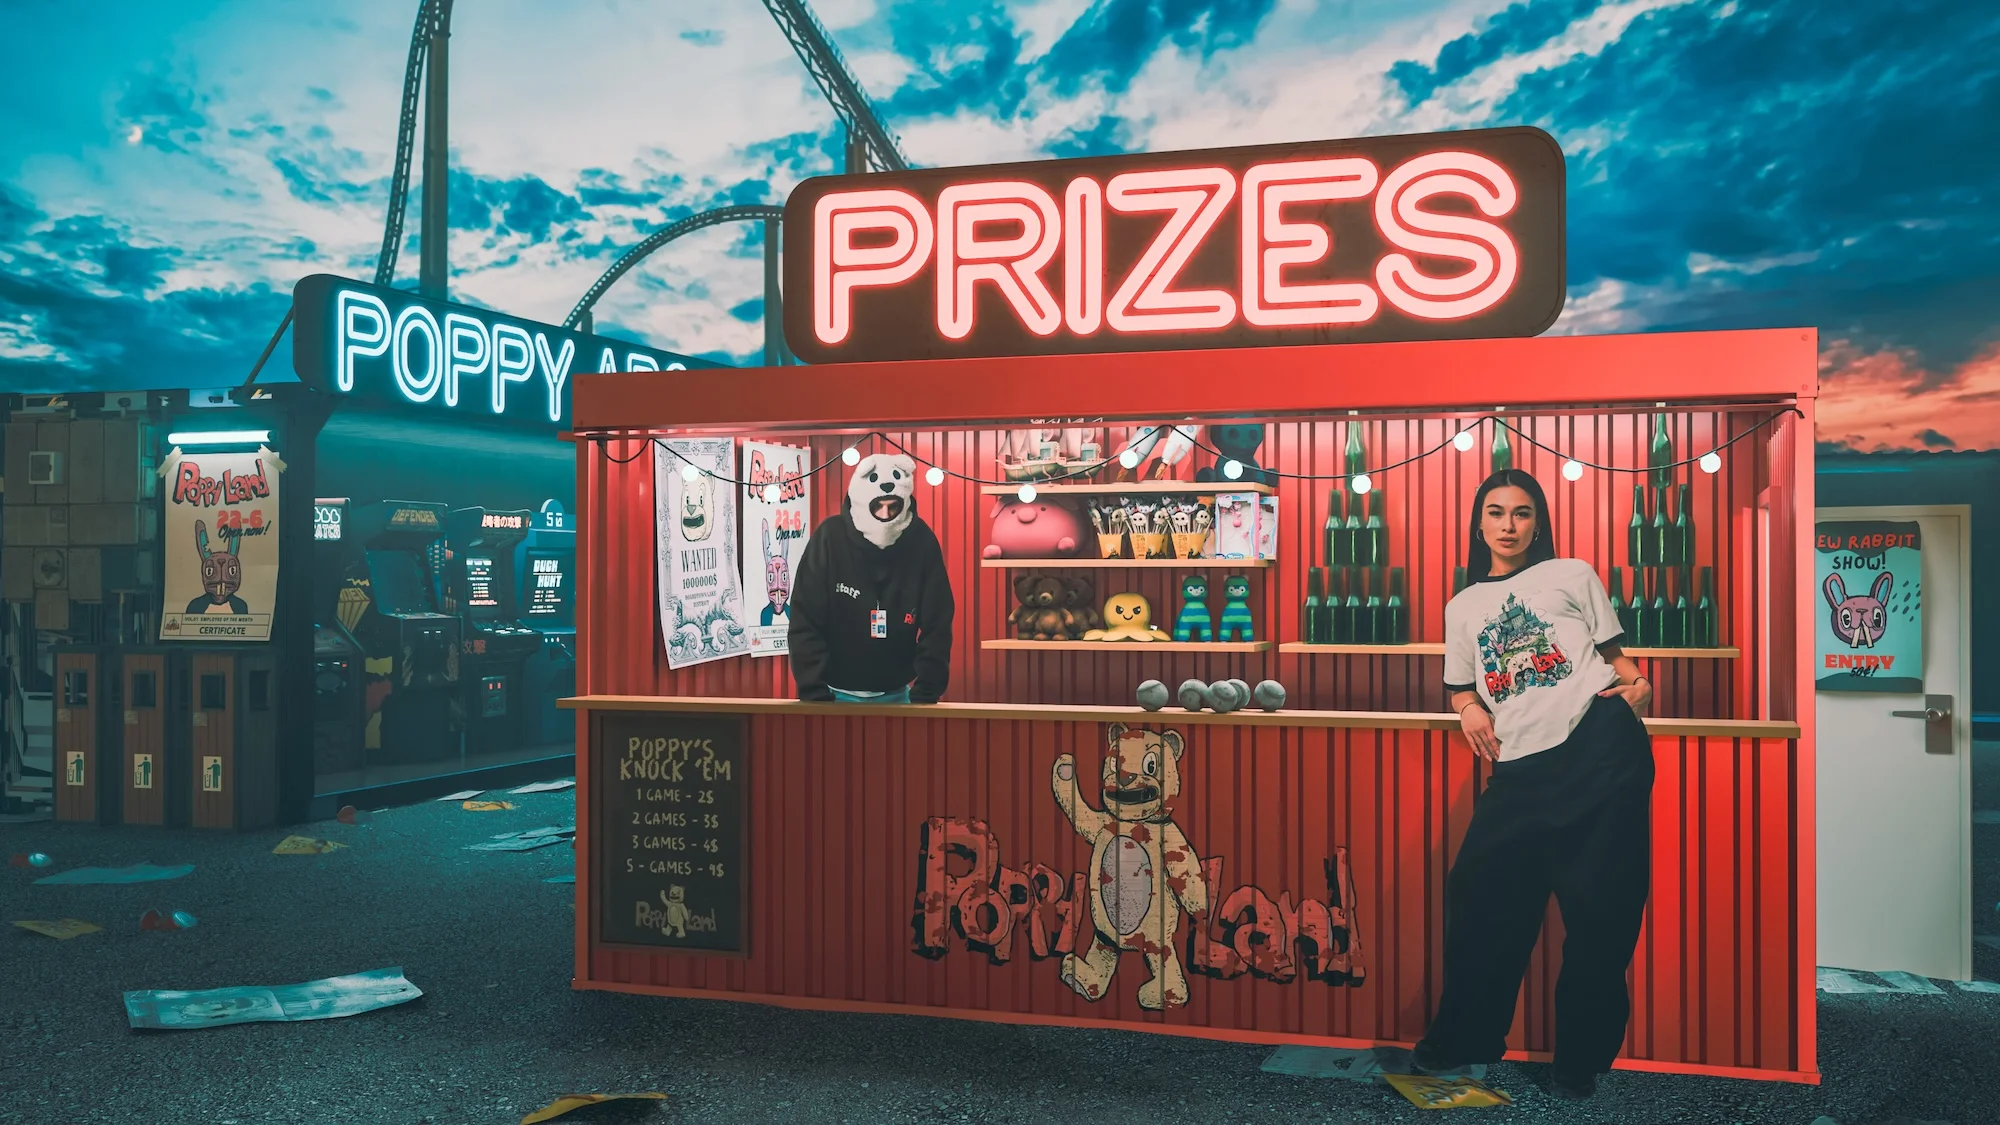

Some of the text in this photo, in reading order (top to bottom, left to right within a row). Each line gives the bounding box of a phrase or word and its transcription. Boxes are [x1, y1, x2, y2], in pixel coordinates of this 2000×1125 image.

[812, 150, 1519, 346] PRIZES
[337, 289, 576, 422] POPPY
[221, 459, 270, 505] Land
[216, 510, 263, 529] 22-6
[392, 509, 438, 523] DEFENDER
[775, 509, 801, 530] 22-6
[217, 524, 243, 543] Open
[1817, 534, 1915, 549] EW RABBIT
[533, 560, 559, 573] DUCK
[681, 547, 717, 573] WANTED
[1832, 551, 1886, 570] SHOW!
[537, 575, 562, 587] HUNT
[682, 573, 717, 589] 1000000$
[199, 626, 247, 635] CERTIFICATE
[773, 639, 788, 648] CERTI
[1531, 643, 1567, 673] Land
[1825, 654, 1895, 670] ENTRY
[628, 737, 715, 761] POPPY'S
[620, 758, 684, 782] KNOCK
[637, 788, 643, 801] 1
[646, 789, 681, 802] GAME
[698, 790, 714, 804] 2$
[632, 812, 641, 825] 2
[644, 813, 687, 827] GAMES
[703, 813, 719, 829] 3$
[632, 835, 640, 849] 3
[643, 836, 686, 851] GAMES
[703, 839, 719, 853] 4$
[626, 858, 634, 873] 5
[650, 860, 692, 875] GAMES
[685, 907, 717, 932] Land
[1186, 846, 1367, 988] Land
